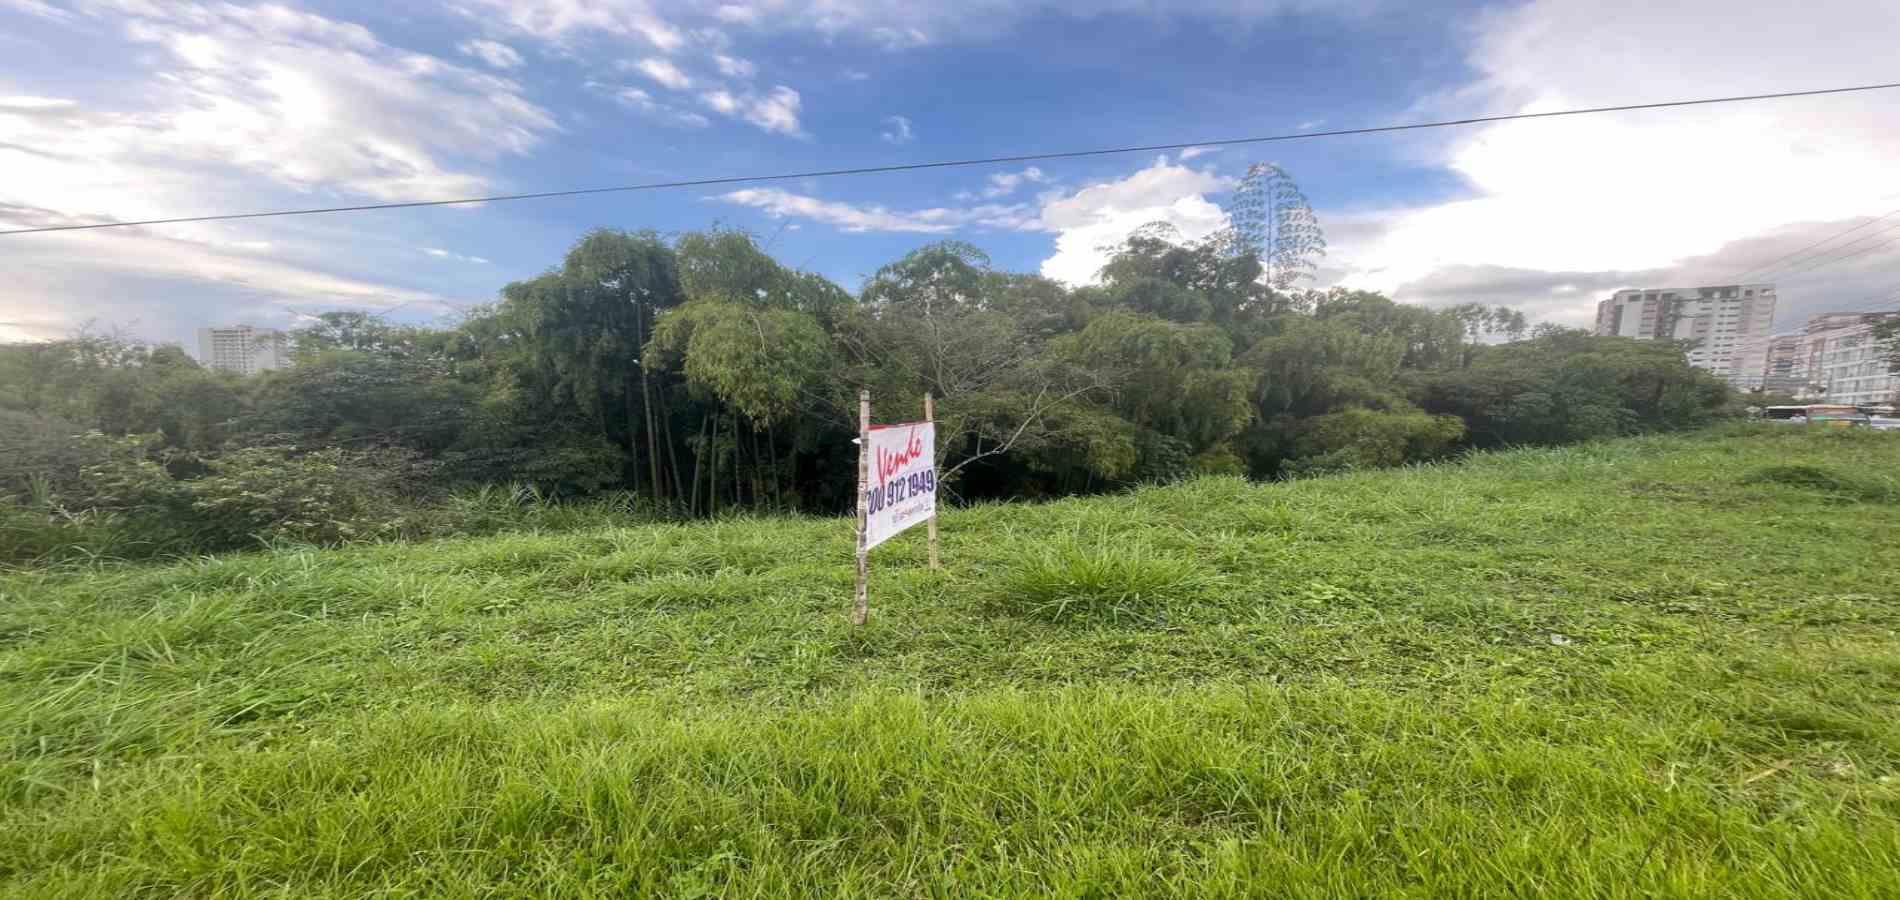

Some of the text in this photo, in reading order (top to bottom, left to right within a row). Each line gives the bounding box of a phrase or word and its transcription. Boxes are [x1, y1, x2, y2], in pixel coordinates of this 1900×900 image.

[876, 426, 922, 485] Vende
[866, 487, 885, 515] 00
[887, 477, 906, 507] 912
[908, 469, 935, 498] 1949
